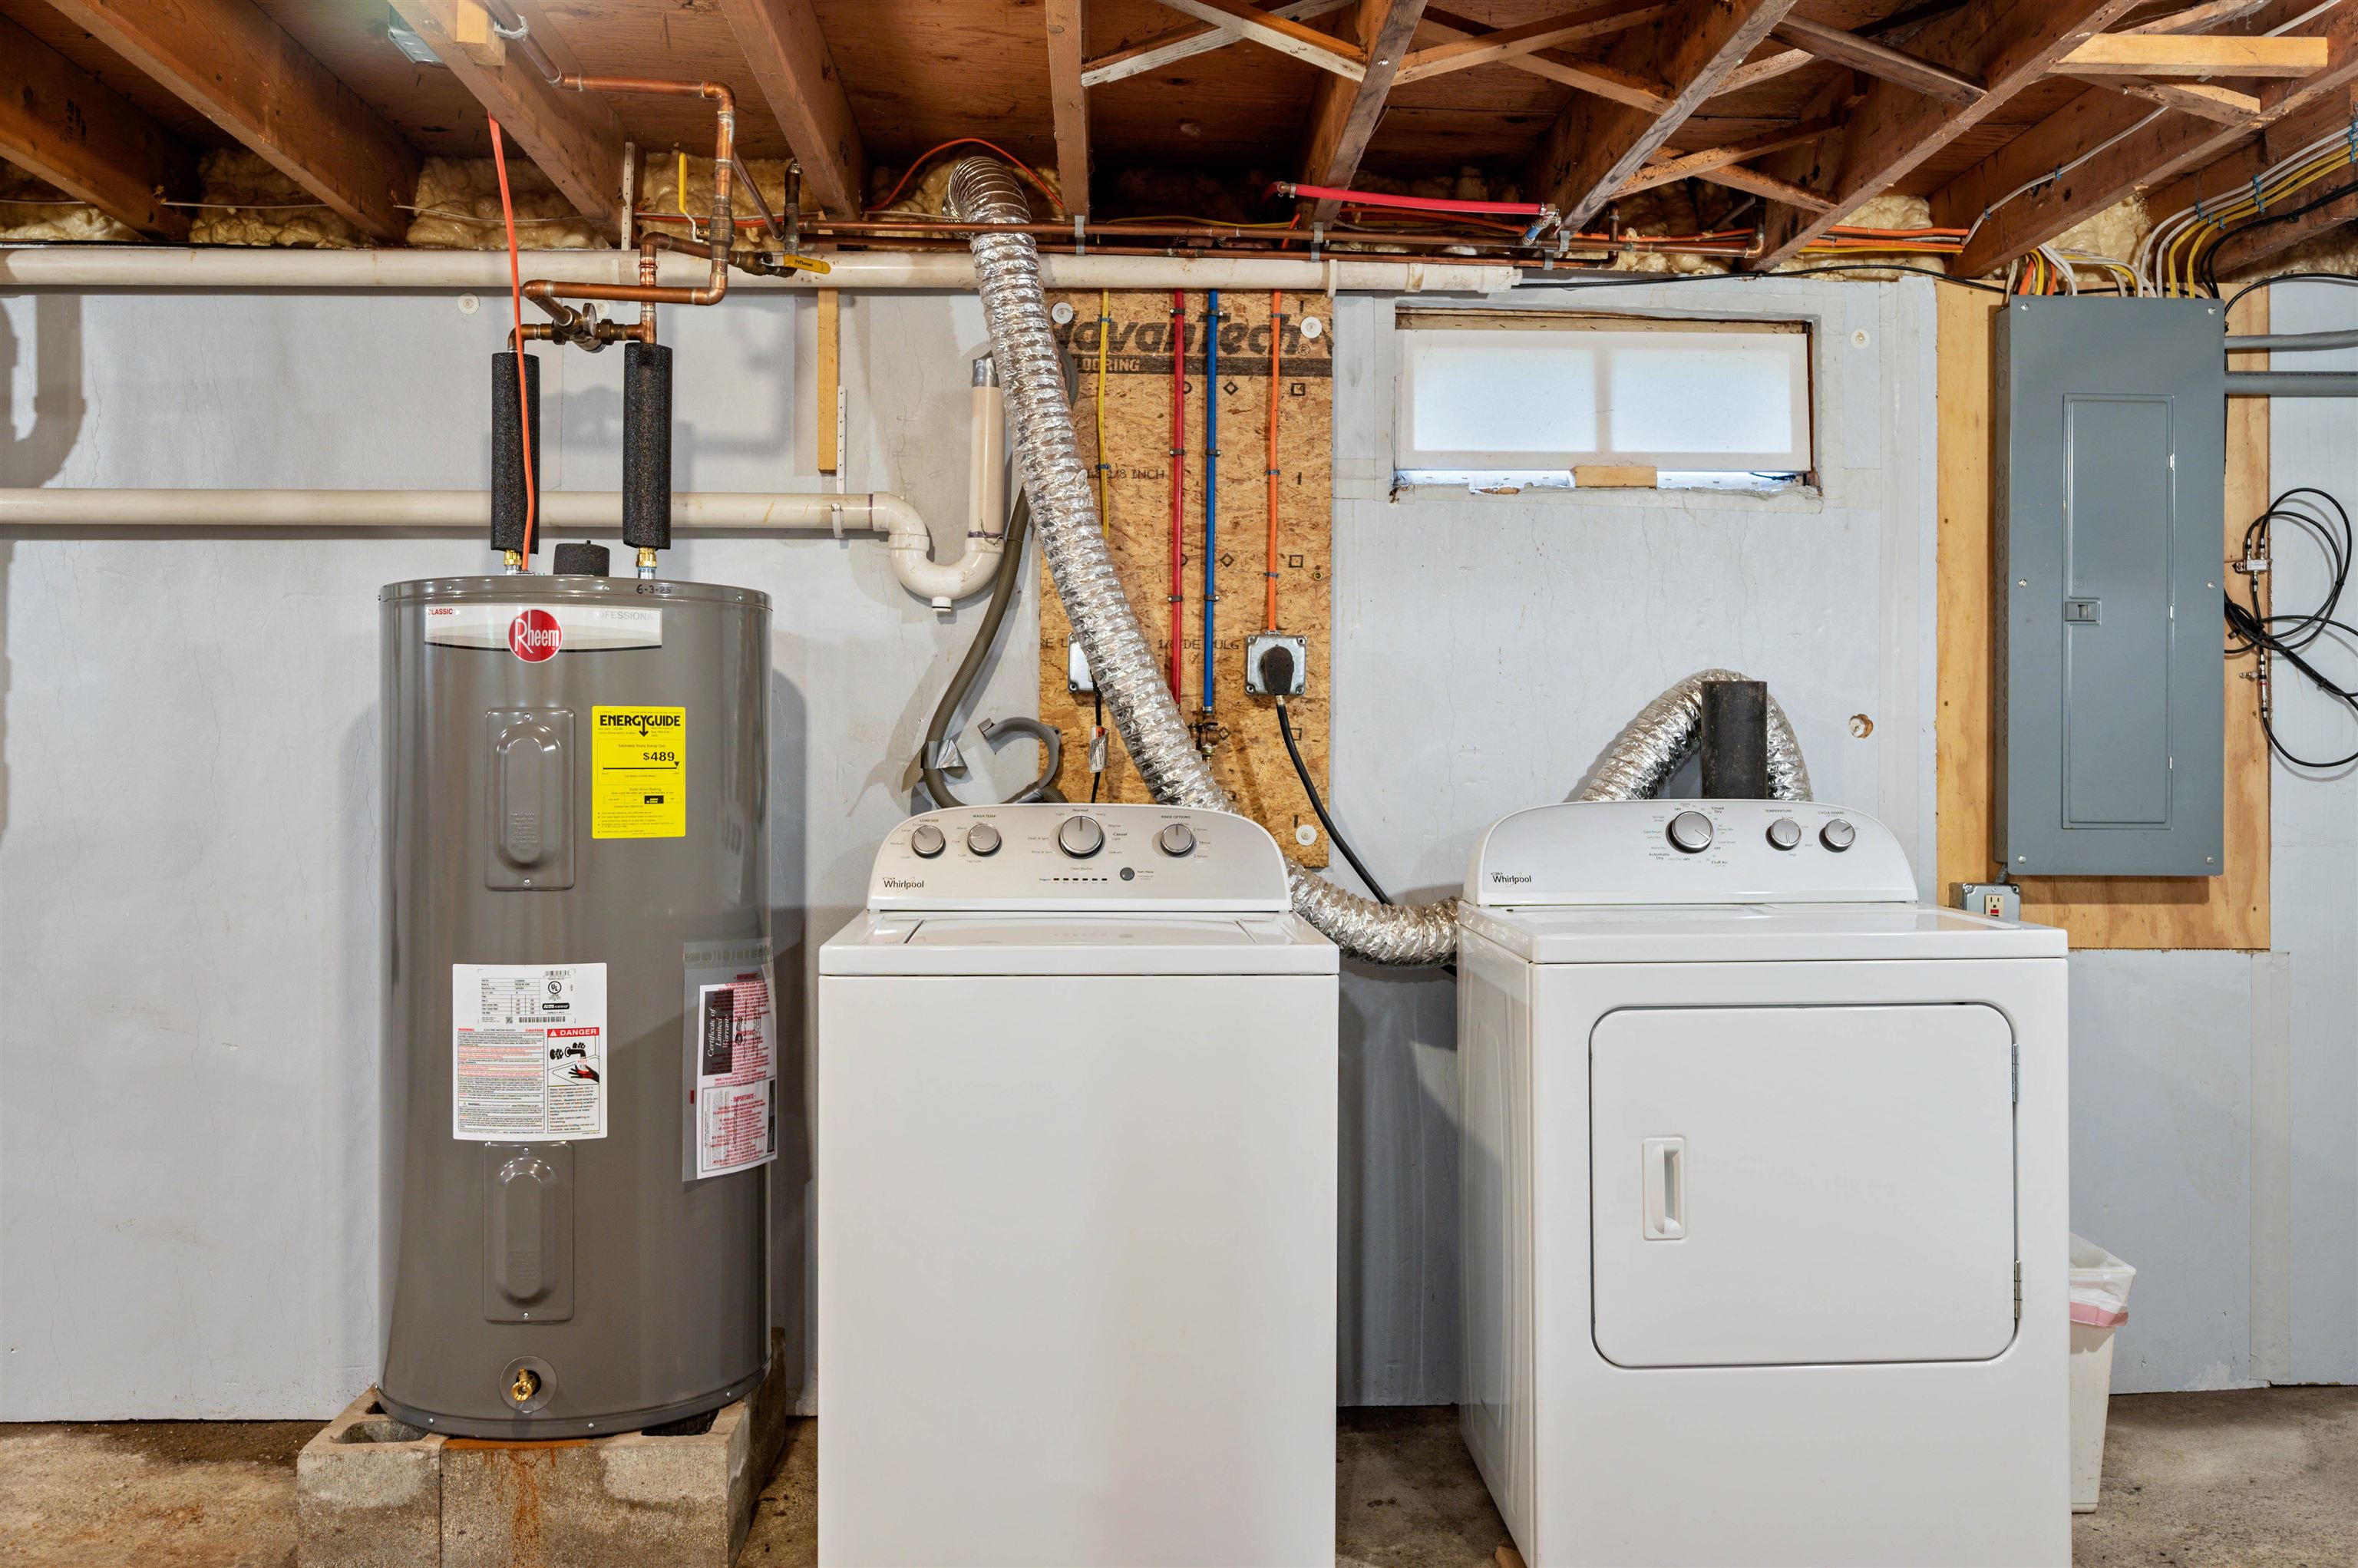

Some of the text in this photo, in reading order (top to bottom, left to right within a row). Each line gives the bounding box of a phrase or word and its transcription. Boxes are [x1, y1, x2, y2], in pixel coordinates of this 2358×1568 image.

[1131, 470, 1164, 479] INCH
[636, 584, 673, 594] 6-3-25
[515, 610, 559, 653] Rheem
[1184, 639, 1200, 649] DE
[1212, 639, 1239, 650] ULG
[599, 715, 680, 727] ENERGYGUIDE
[643, 751, 675, 761] $489
[1492, 875, 1531, 884] Whirlpool
[884, 880, 924, 890] Whirlpool
[708, 1007, 717, 1017] of
